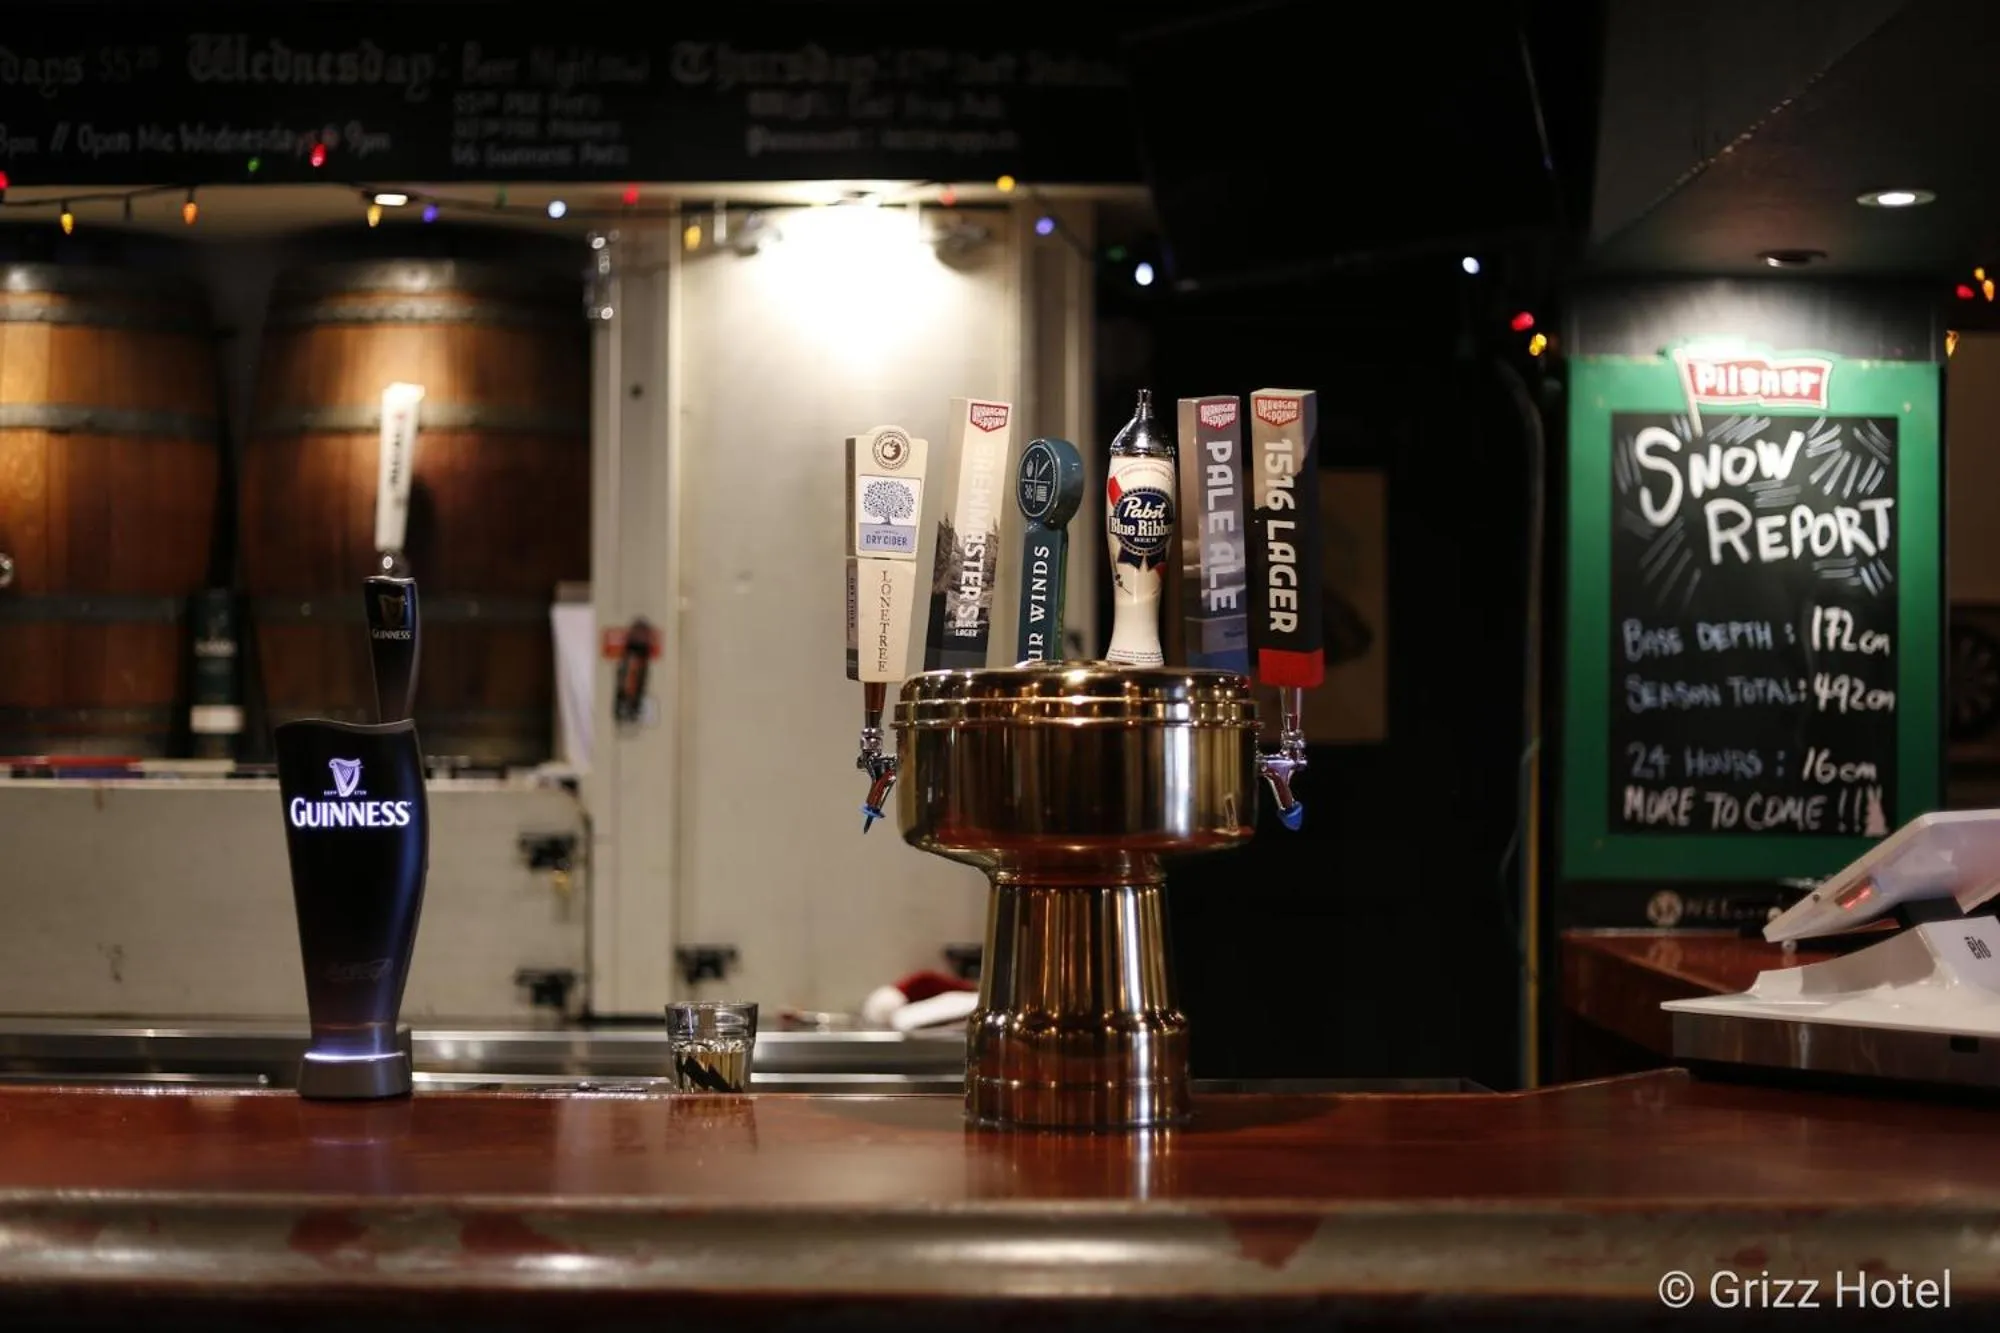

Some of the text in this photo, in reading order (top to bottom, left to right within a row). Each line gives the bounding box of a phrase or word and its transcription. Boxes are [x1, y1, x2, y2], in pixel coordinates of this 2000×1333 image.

[77, 122, 131, 160] Open
[1696, 362, 1820, 397] Pilsner
[1206, 439, 1234, 534] PALE
[1264, 438, 1296, 512] 1516
[1110, 516, 1136, 536] Blue
[1123, 496, 1167, 519] Pabst
[866, 534, 908, 547] DRY CIDER
[1030, 545, 1050, 623] WINDS
[1209, 541, 1238, 612] ALE
[1266, 519, 1298, 634] LAGER
[371, 628, 411, 640] GUINNESS
[1696, 620, 1773, 652] DEPTH
[1627, 742, 1671, 780] 24
[290, 796, 411, 827] GUINNESS
[1623, 784, 1695, 828] MORE
[1705, 791, 1740, 831] TO
